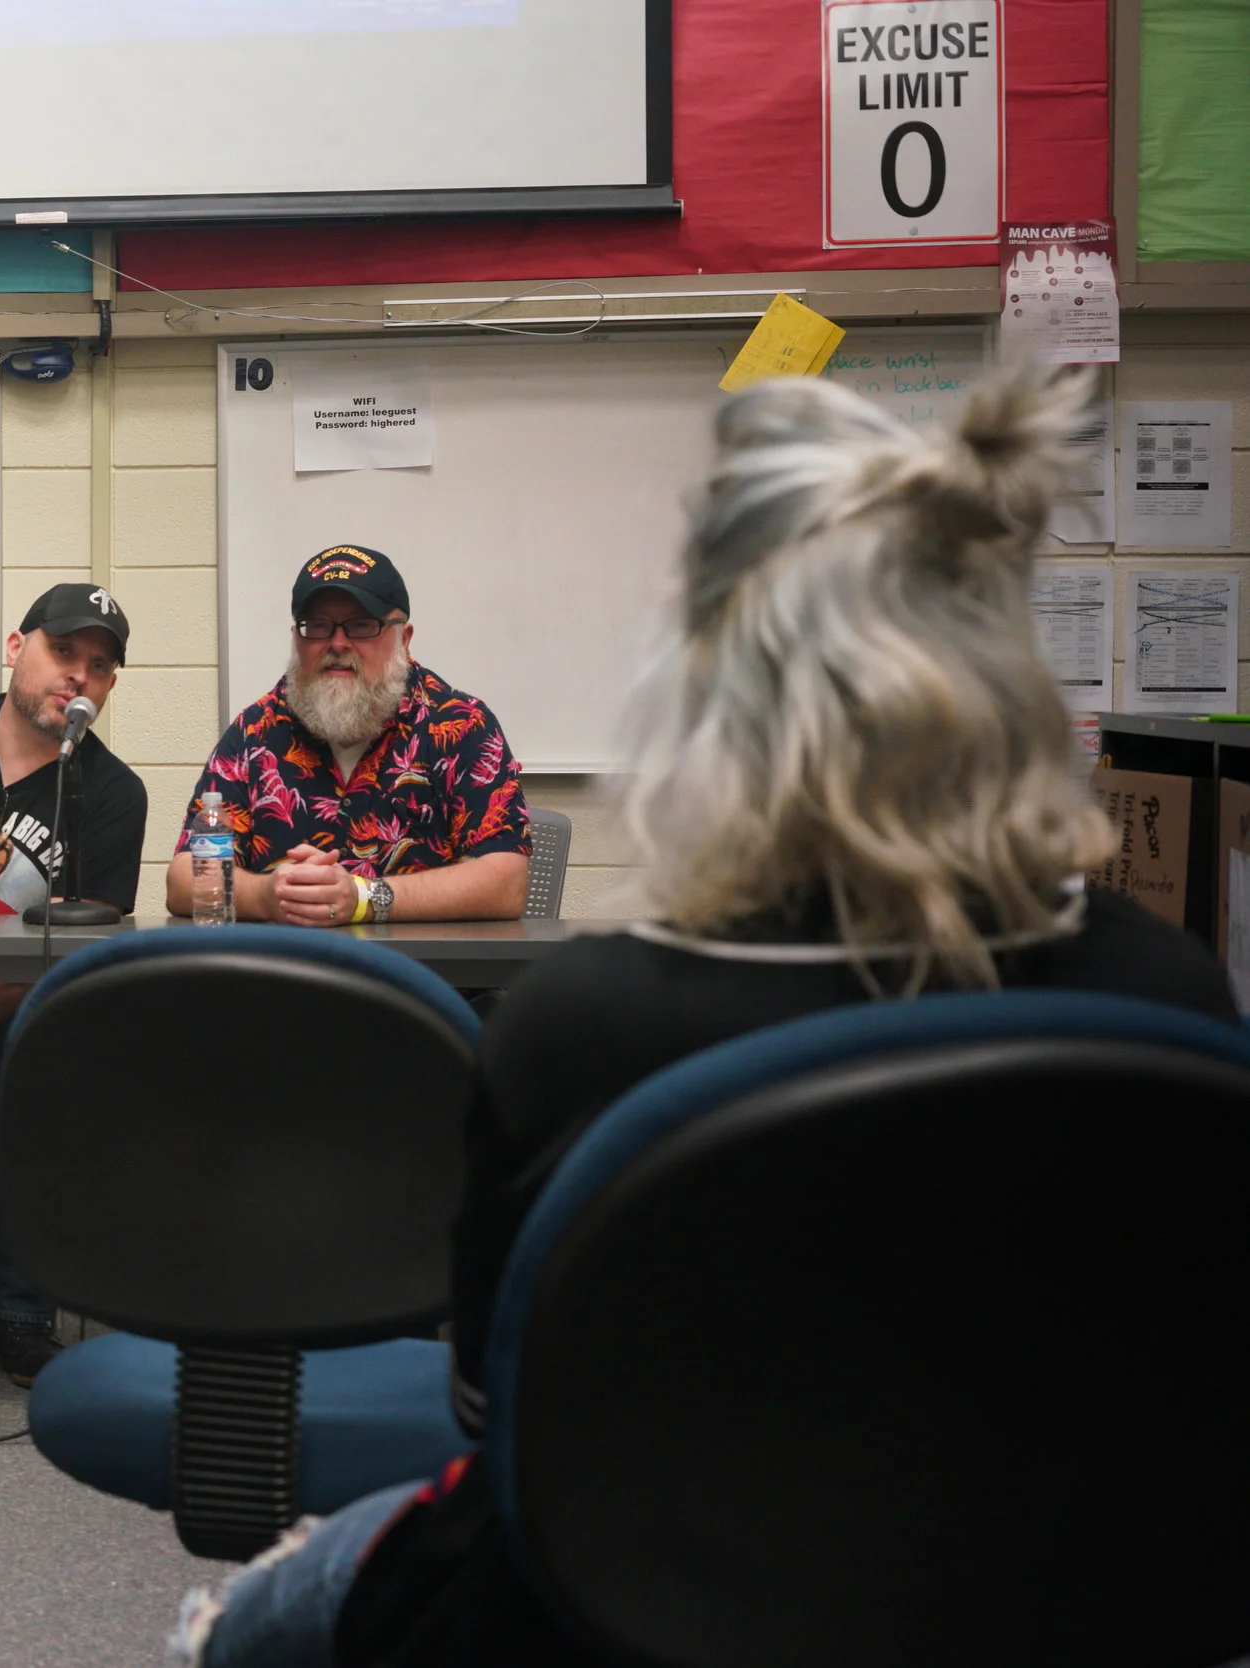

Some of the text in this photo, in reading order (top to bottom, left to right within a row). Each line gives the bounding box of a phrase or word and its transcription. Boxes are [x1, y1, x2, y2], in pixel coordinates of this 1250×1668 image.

[837, 22, 989, 63] EXCUSE
[859, 71, 969, 111] LIMIT
[881, 120, 946, 218] 0
[1008, 225, 1109, 239] MAN CAVE MONDAY
[886, 351, 936, 371] wrist
[314, 407, 417, 418] Username: leeguest
[352, 397, 377, 406] WIFI
[315, 418, 416, 430] Password: highered
[321, 546, 377, 568] INDEPENDENCE
[1, 811, 19, 839] A
[11, 814, 50, 852] BIG
[1121, 791, 1135, 853] Tri-Fold
[1141, 796, 1161, 859] Pacon
